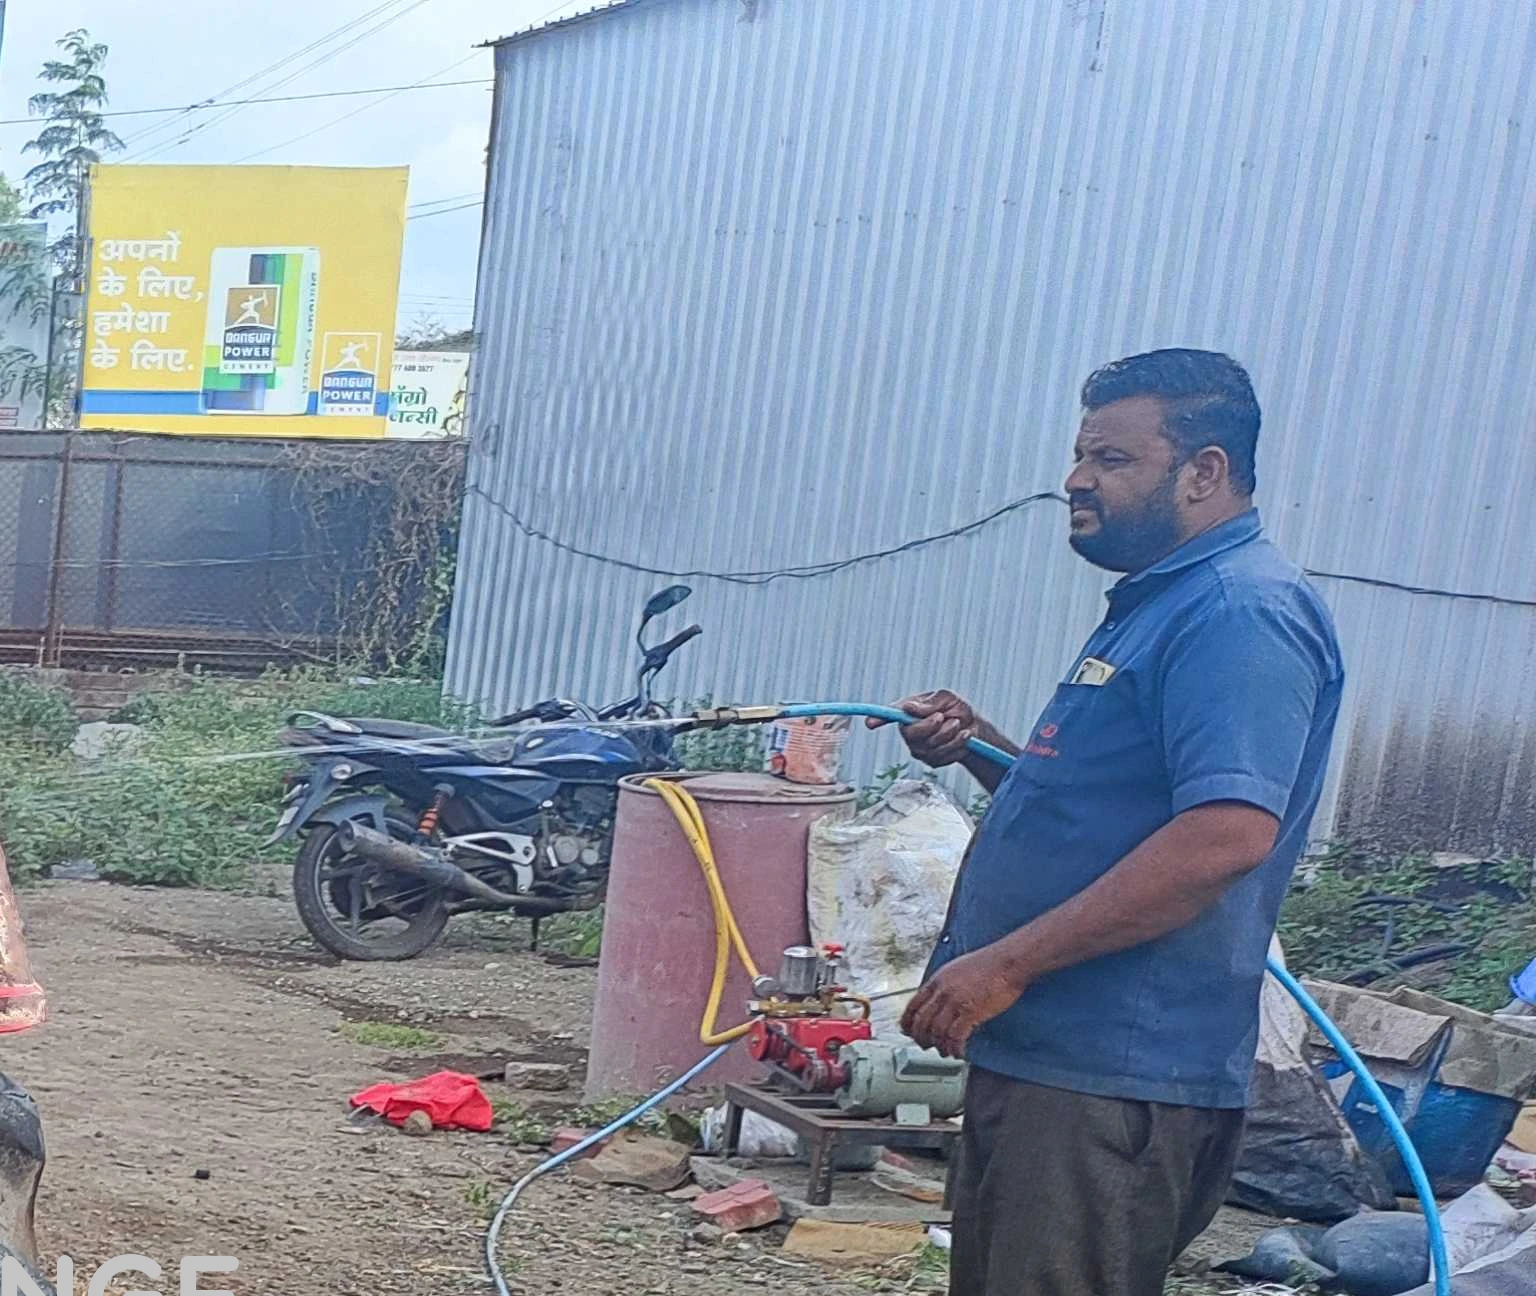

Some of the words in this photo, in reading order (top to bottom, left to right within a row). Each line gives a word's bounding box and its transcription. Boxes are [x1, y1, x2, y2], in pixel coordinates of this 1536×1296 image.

[95, 265, 127, 297] के
[92, 301, 172, 337] हमेशा
[89, 338, 121, 369] के
[224, 346, 270, 357] POWER
[322, 390, 371, 401] POWER
